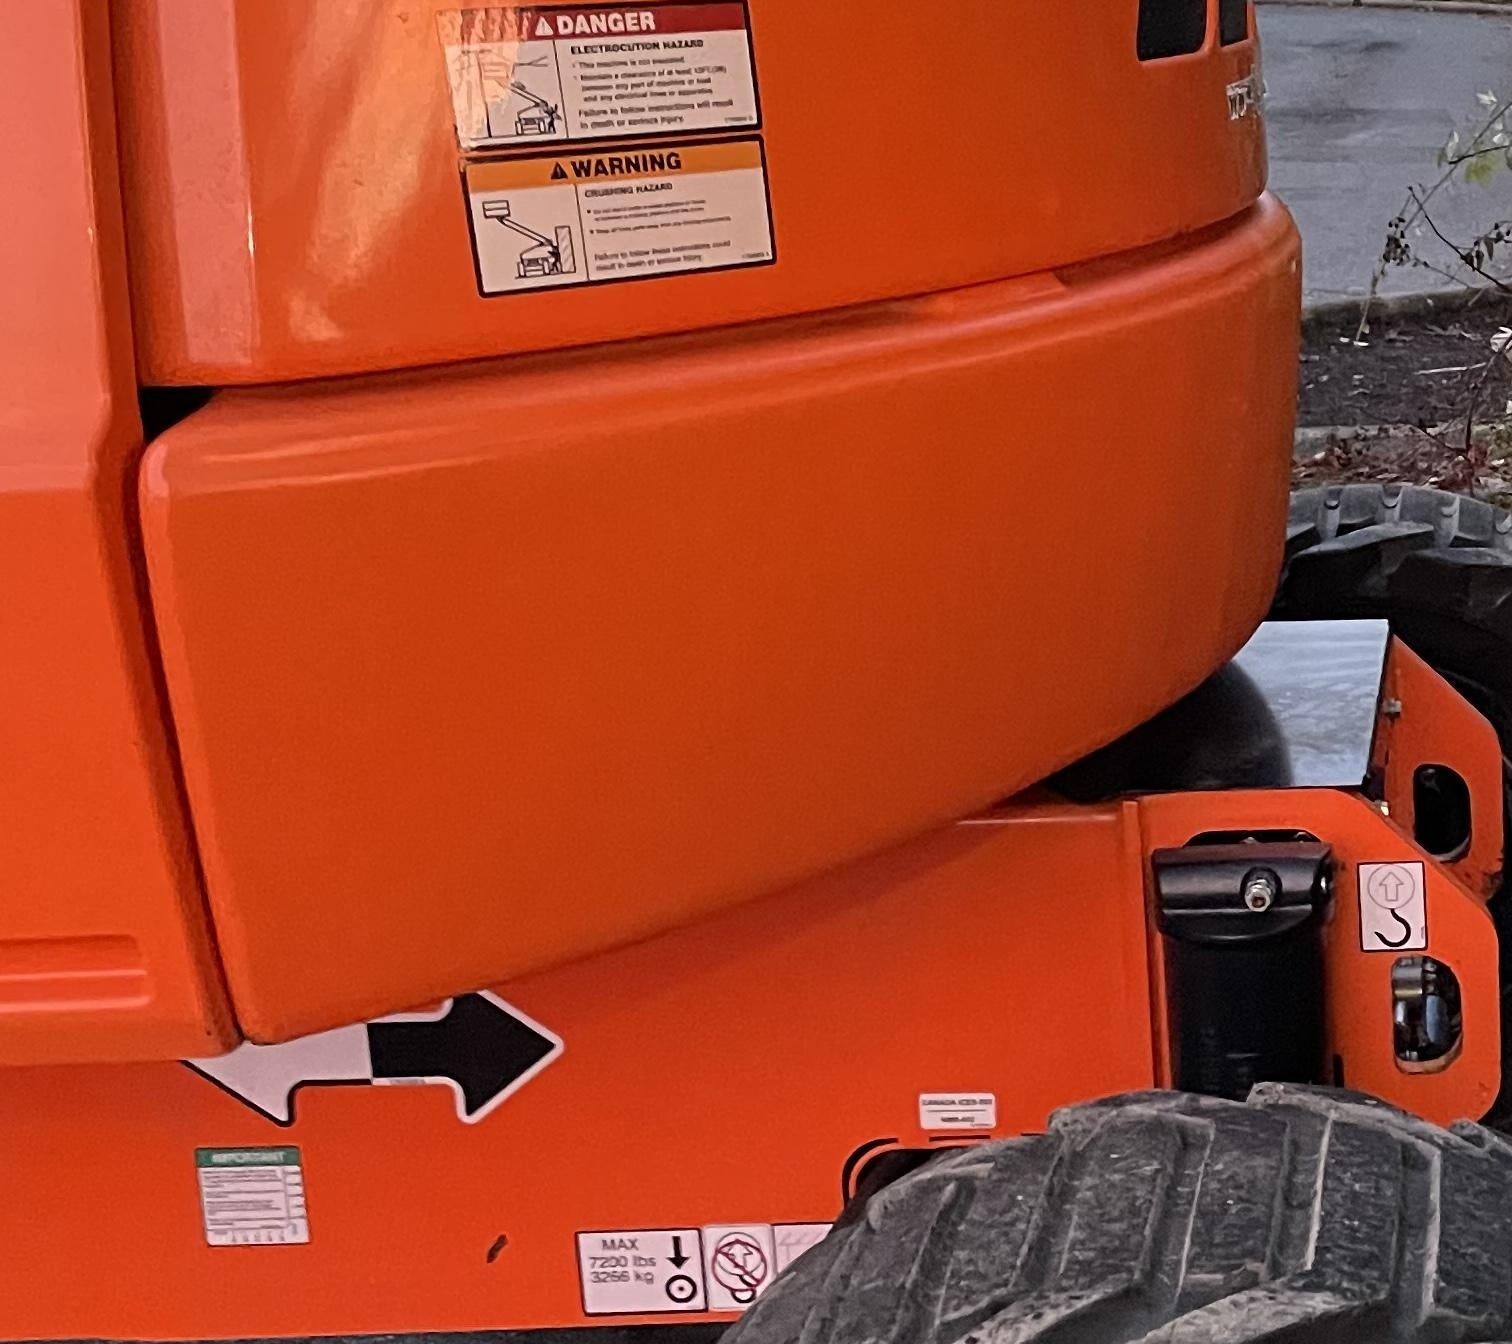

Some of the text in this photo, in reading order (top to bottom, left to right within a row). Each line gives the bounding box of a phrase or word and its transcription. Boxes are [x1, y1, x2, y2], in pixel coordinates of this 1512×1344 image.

[557, 11, 655, 35] DANGER
[571, 39, 704, 55] ELECTROCUTION HAZARD
[571, 152, 682, 178] WARNING
[636, 182, 673, 193] HAZARD
[601, 1238, 639, 1250] MAX
[633, 1255, 657, 1267] lbs
[634, 1271, 654, 1284] kg
